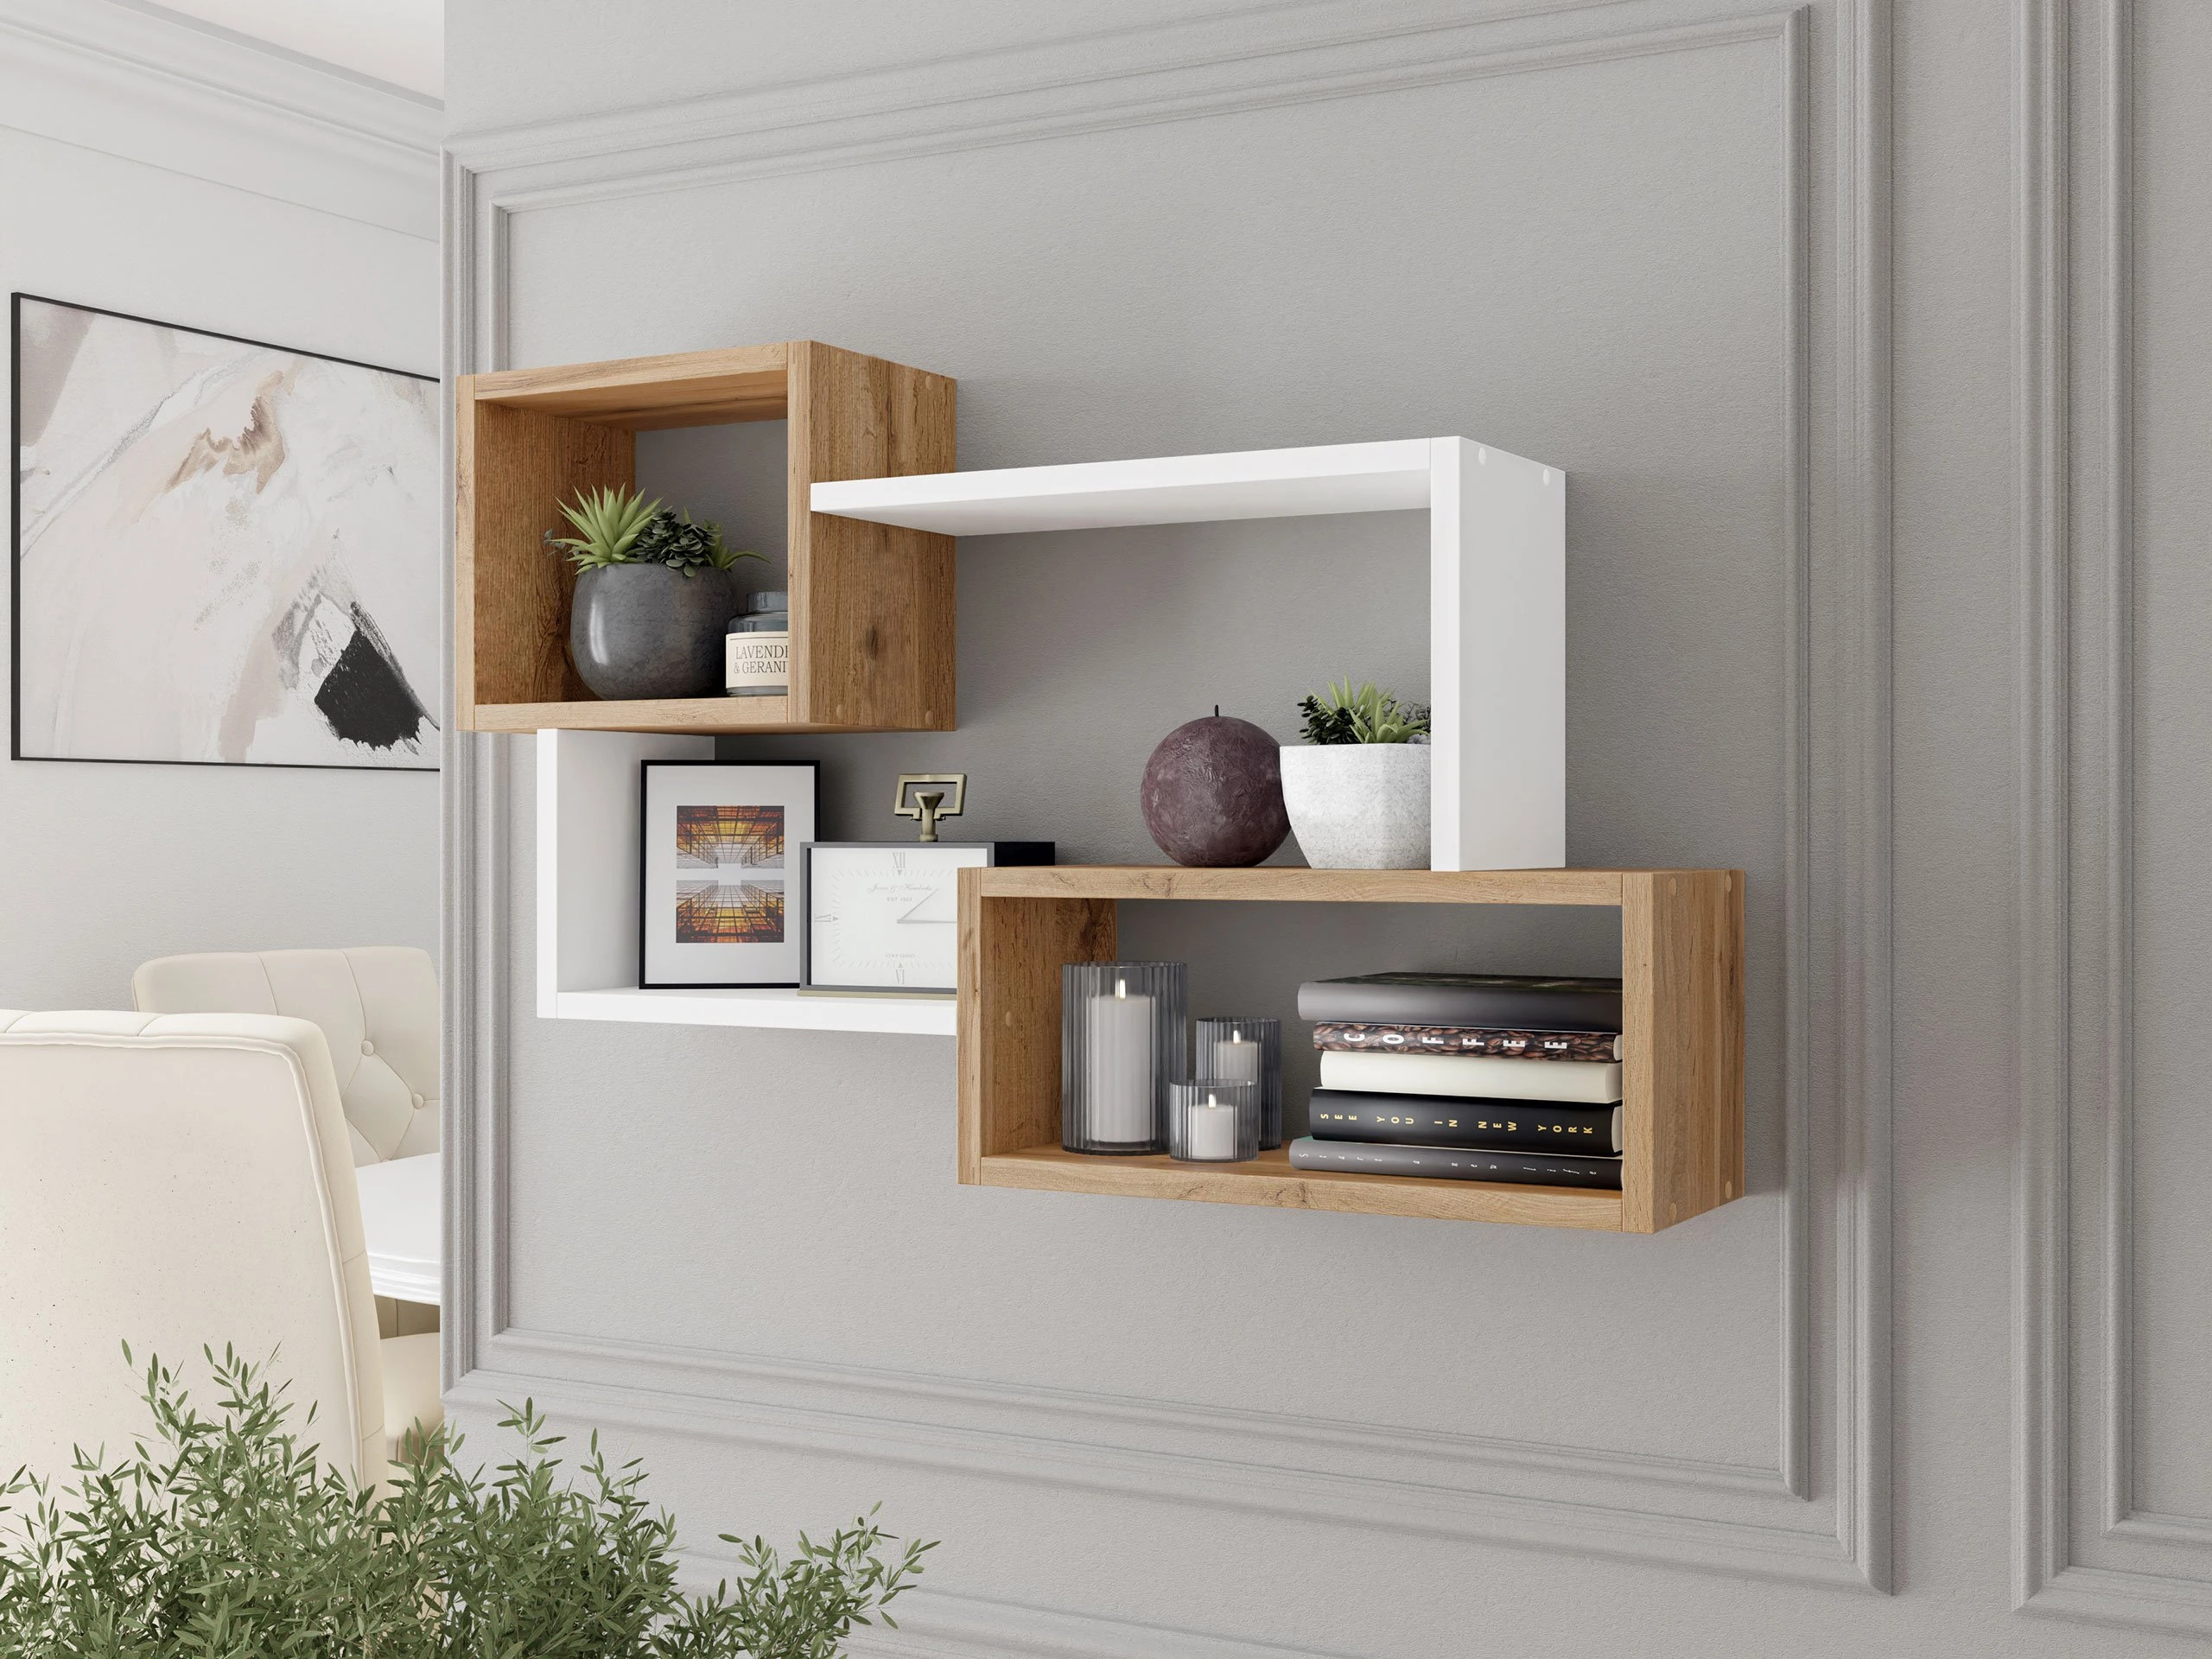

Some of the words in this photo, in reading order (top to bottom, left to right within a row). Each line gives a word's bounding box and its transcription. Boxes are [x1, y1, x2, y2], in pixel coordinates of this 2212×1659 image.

[734, 662, 741, 674] &
[741, 660, 788, 674] GERANI
[892, 851, 906, 868] XII
[895, 969, 906, 985] VI
[1344, 1033, 1567, 1050] COFFEE
[1320, 1113, 1357, 1122] SEE
[1376, 1116, 1414, 1125] YOU
[1433, 1119, 1458, 1128] IN
[1478, 1121, 1517, 1132] NEW
[1537, 1124, 1593, 1135] YORK
